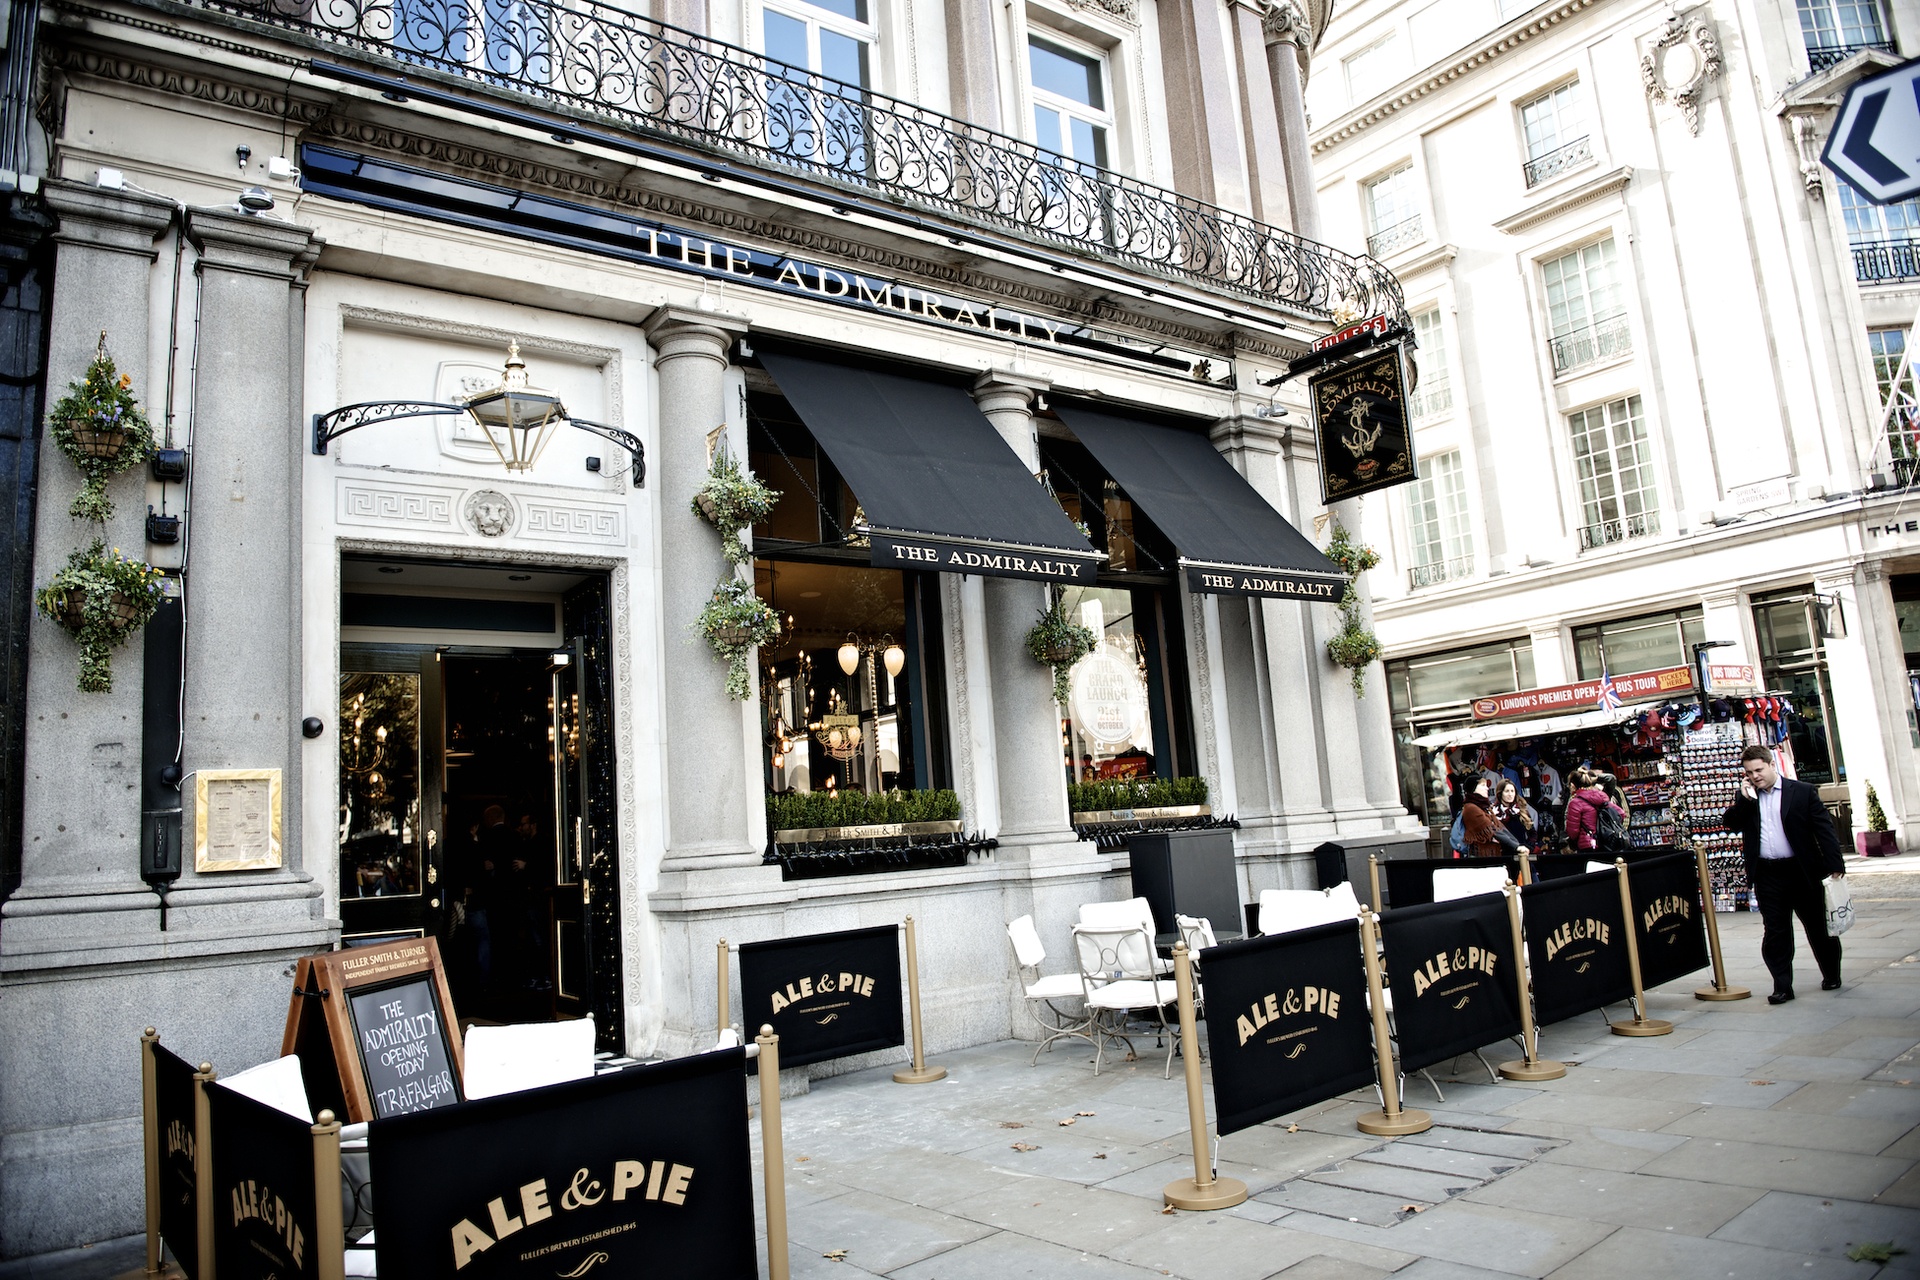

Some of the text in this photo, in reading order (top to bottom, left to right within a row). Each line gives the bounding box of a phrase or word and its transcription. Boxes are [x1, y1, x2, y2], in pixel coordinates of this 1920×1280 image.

[635, 226, 1068, 345] THE ADMIRALTY
[1345, 371, 1366, 383] THE
[1321, 380, 1399, 424] ADMIRALTY
[1736, 486, 1761, 497] SPRING
[1737, 491, 1769, 505] GARDENS
[1867, 520, 1919, 538] THE
[891, 544, 1082, 578] THE ADMIRALTY
[1201, 573, 1335, 597] THE ADMIRALTY
[1088, 673, 1123, 687] GRAND
[1095, 660, 1115, 674] THE
[1660, 671, 1687, 682] TICKETS
[1086, 687, 1128, 701] LAUNCH
[1500, 695, 1538, 711] LONDON'S
[1538, 689, 1573, 704] PREMIER
[1615, 680, 1632, 694] BUS
[1633, 676, 1657, 691] TOUR
[1666, 677, 1684, 687] HERE
[1130, 809, 1151, 819] SMITH
[854, 827, 880, 838] SMITH
[881, 826, 888, 835] &
[892, 824, 921, 834] TURNER
[1643, 895, 1690, 933] ALE & PIE
[1545, 917, 1610, 962] ALE & PIE
[342, 945, 427, 971] FULLER SMITH & TURNER
[345, 967, 375, 980] INDEPENDENT
[374, 965, 390, 974] FAMILY
[389, 961, 408, 971] BREWERS
[1413, 951, 1451, 998] ALE
[1452, 947, 1467, 972] &
[1468, 946, 1497, 977] PIE
[770, 976, 814, 1015] ALE
[816, 973, 836, 994] &
[838, 971, 876, 998] PIE
[380, 1000, 405, 1020] THE
[1236, 992, 1281, 1047] ALE
[1282, 988, 1302, 1016] &
[1304, 985, 1341, 1020] PIE
[364, 1010, 437, 1053] ADMIRALTY
[380, 1039, 429, 1067] OPENING
[395, 1053, 425, 1078] TODAY
[377, 1070, 454, 1113] TRAFALGAR
[167, 1119, 181, 1158] ALE
[181, 1124, 188, 1156] &
[231, 1179, 259, 1228] ALE
[260, 1186, 275, 1226] &
[275, 1194, 304, 1271] PIE
[450, 1159, 695, 1271] ALE & PIE
[520, 1221, 637, 1261] FULLER'S BREWERY ESTABLISHED 1845
